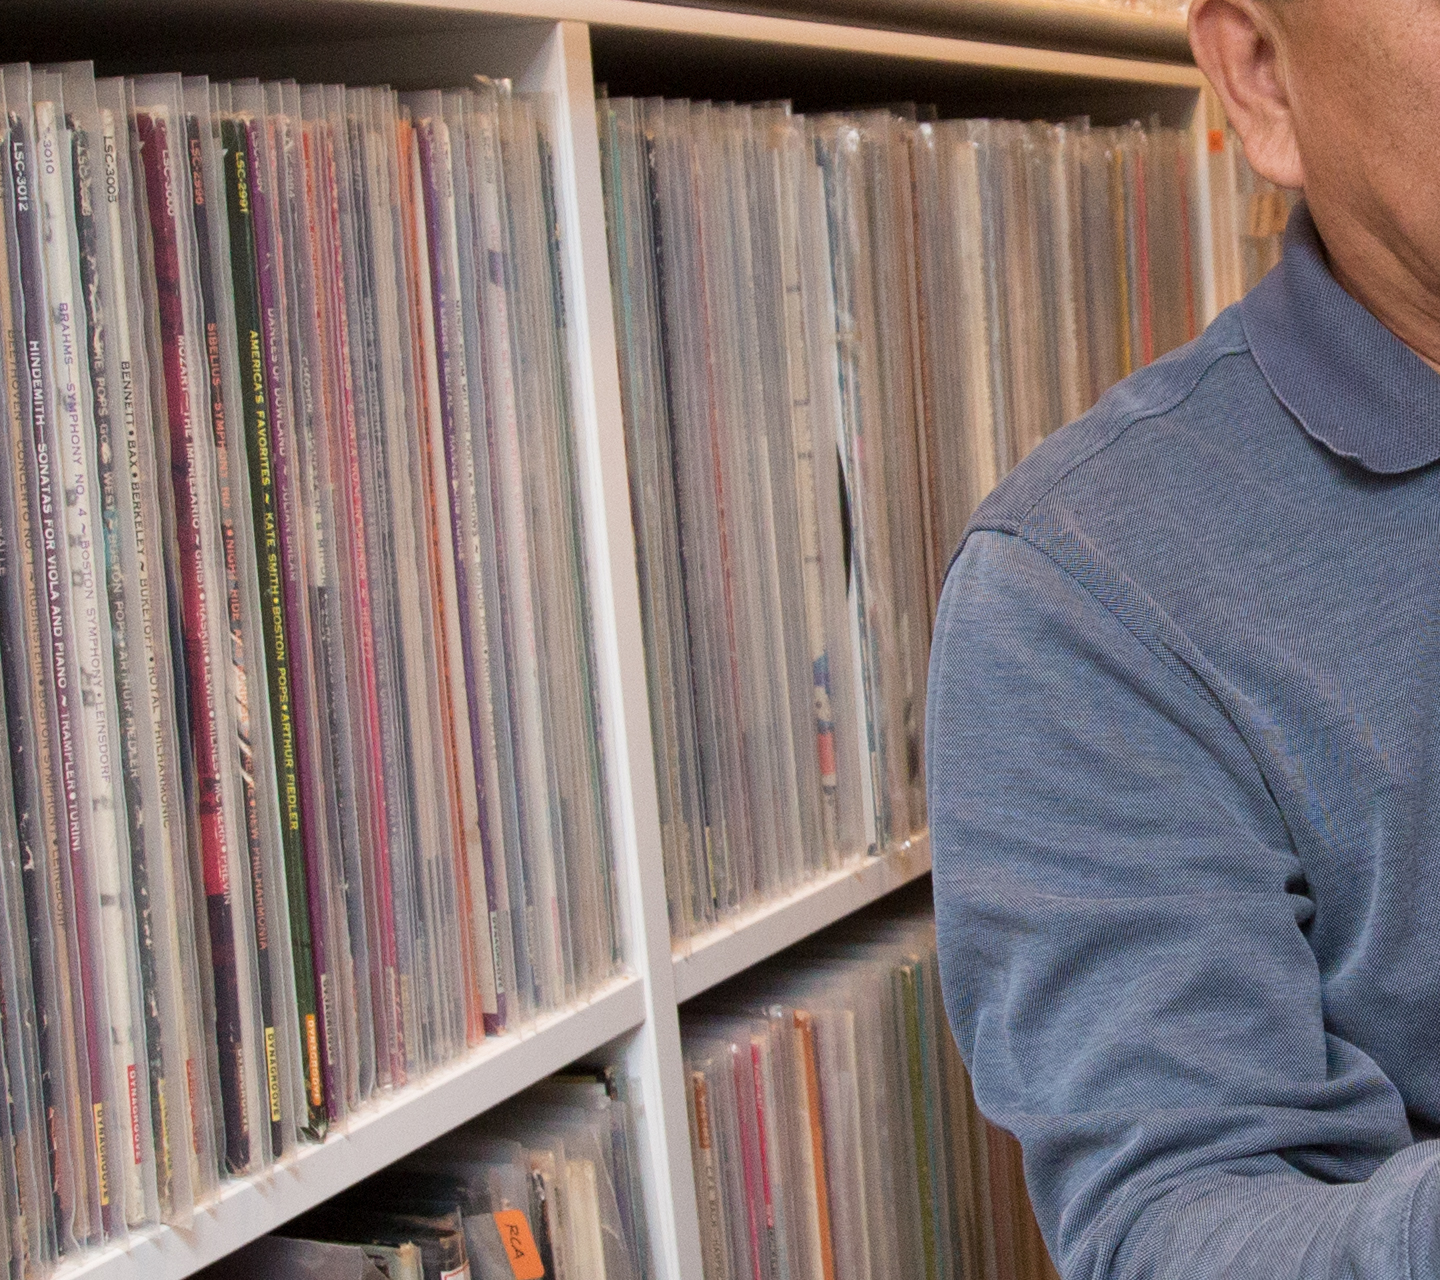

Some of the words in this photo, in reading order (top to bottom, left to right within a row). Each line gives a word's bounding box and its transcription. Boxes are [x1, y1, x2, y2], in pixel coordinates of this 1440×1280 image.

[13, 142, 28, 211] LSC-3012
[103, 135, 117, 202] LSC-3005
[249, 330, 263, 403] AMERICA'S
[272, 366, 281, 383] OF
[94, 377, 107, 415] POPS
[120, 361, 134, 425] BENNETT
[273, 387, 286, 455] DOWLAND
[126, 440, 138, 467] BAX
[255, 410, 269, 485] FAVORITES
[73, 474, 84, 496] NO.
[43, 519, 56, 548] FOR
[130, 481, 146, 555] BERKELEY
[264, 512, 275, 546] KATE
[46, 554, 60, 599] VIOLA
[79, 540, 93, 599] BOSTON
[226, 540, 237, 580] NIGHT
[267, 553, 279, 594] SMITH
[50, 605, 63, 637] AND
[230, 589, 240, 620] RIDE
[85, 608, 101, 688] SYMPHONY
[271, 606, 284, 660] BOSTON
[53, 642, 68, 688] PIANO
[119, 651, 132, 709] ARTHUR
[146, 666, 160, 713] ROYAL
[203, 665, 215, 708] LEWIS
[276, 668, 287, 702] POPS
[59, 712, 76, 790] TRAMPLER
[94, 702, 110, 783] LEINSDORF
[124, 718, 138, 777] FIEDLER
[208, 720, 220, 770] MILNES
[280, 713, 293, 767] ARTHUR
[151, 720, 171, 828] PHILHARMONIC
[248, 809, 258, 839] NEW
[285, 774, 298, 829] FIEDLER
[66, 804, 81, 851] TURINI
[218, 855, 231, 904] PREVIN
[251, 847, 267, 949] PHILHARMONIA
[266, 1033, 280, 1116] DYNAGROOVE
[504, 1223, 525, 1259] RCA
